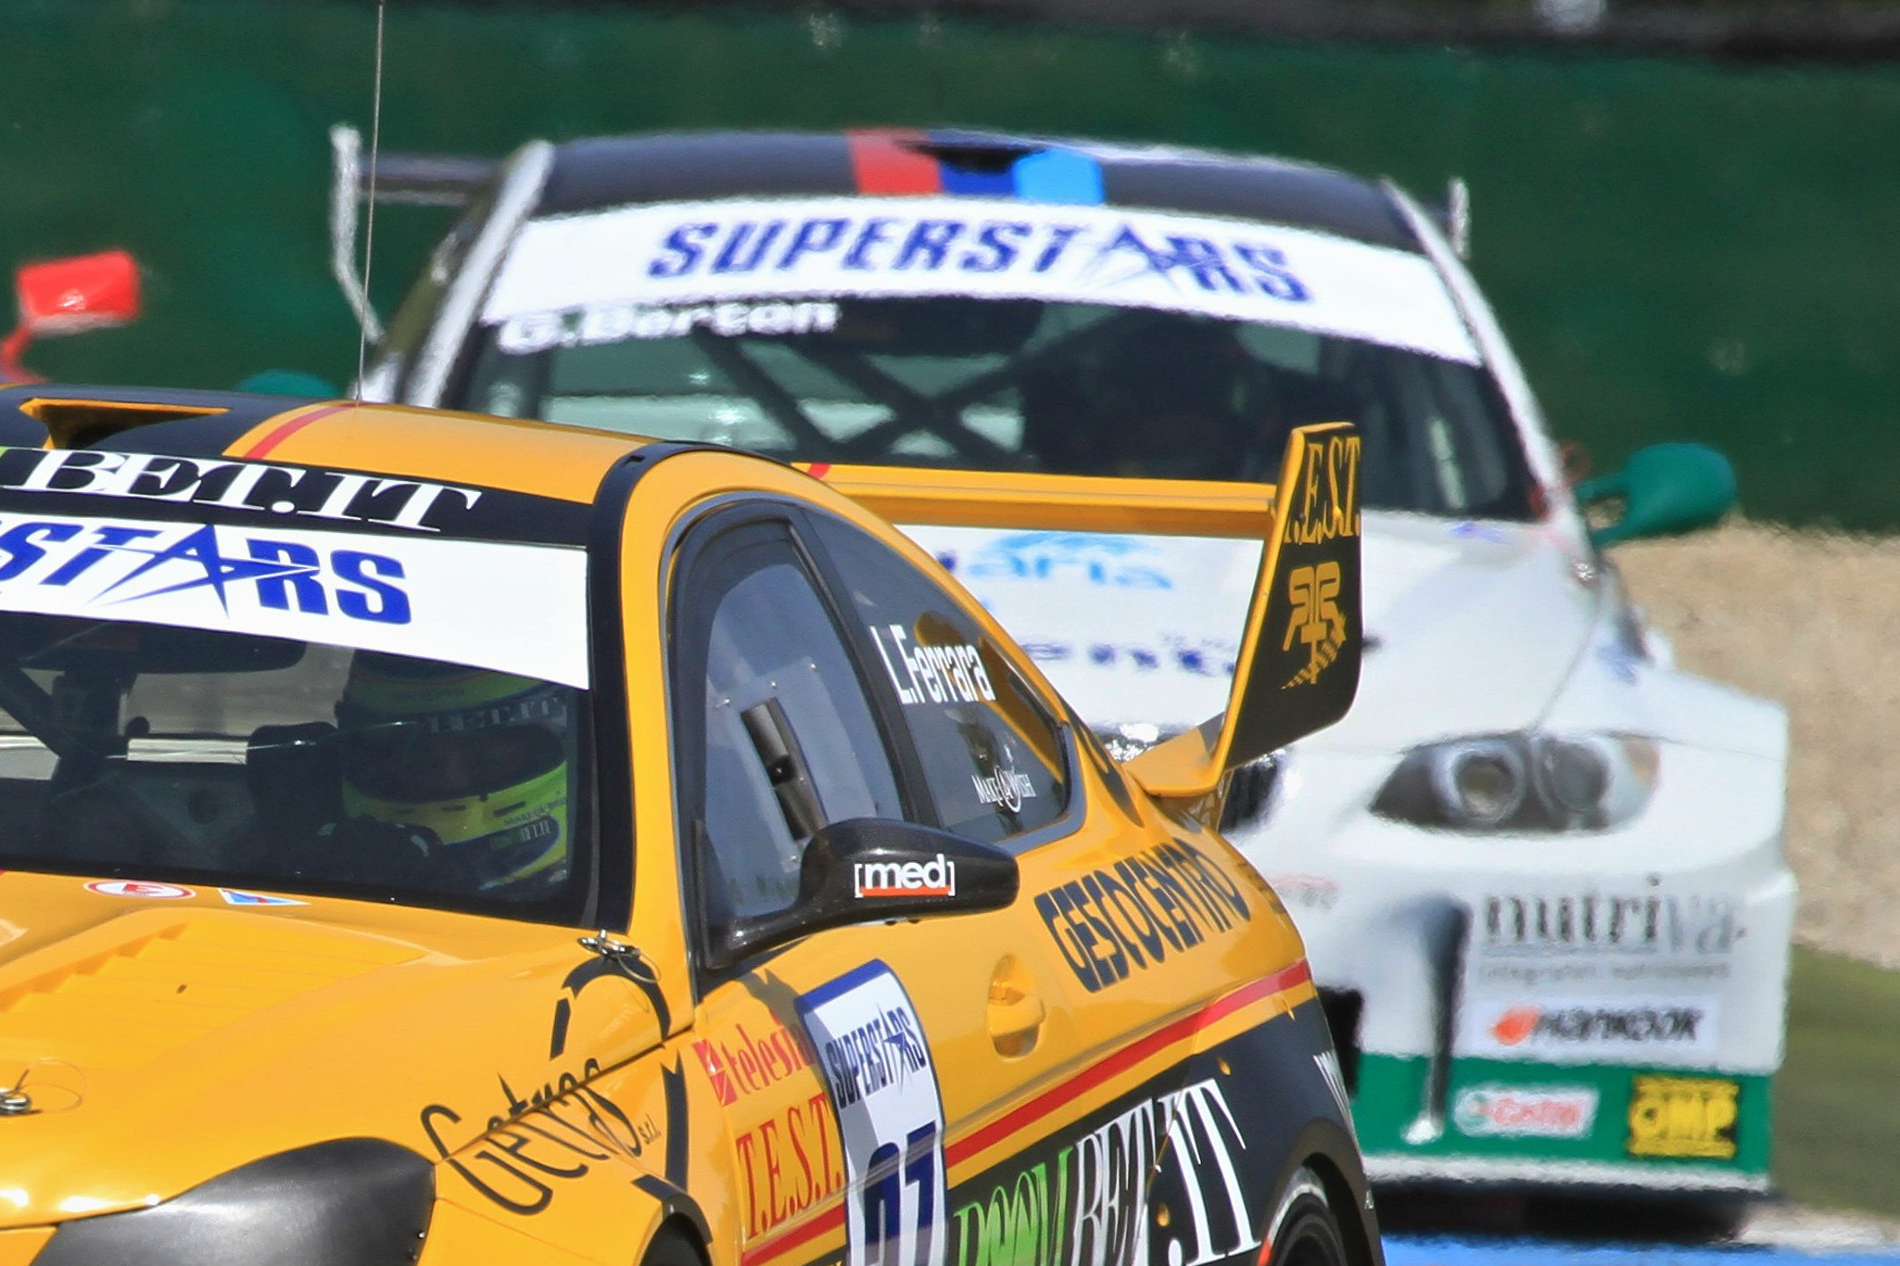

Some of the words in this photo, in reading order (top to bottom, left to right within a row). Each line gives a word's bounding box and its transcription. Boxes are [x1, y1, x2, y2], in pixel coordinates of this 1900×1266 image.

[647, 218, 1314, 302] SUPERSTARS
[1034, 837, 1251, 993] GESCOCENTRO
[826, 1003, 928, 1109] SUPERSTARS
[736, 1092, 843, 1241] T.E.S.T.
